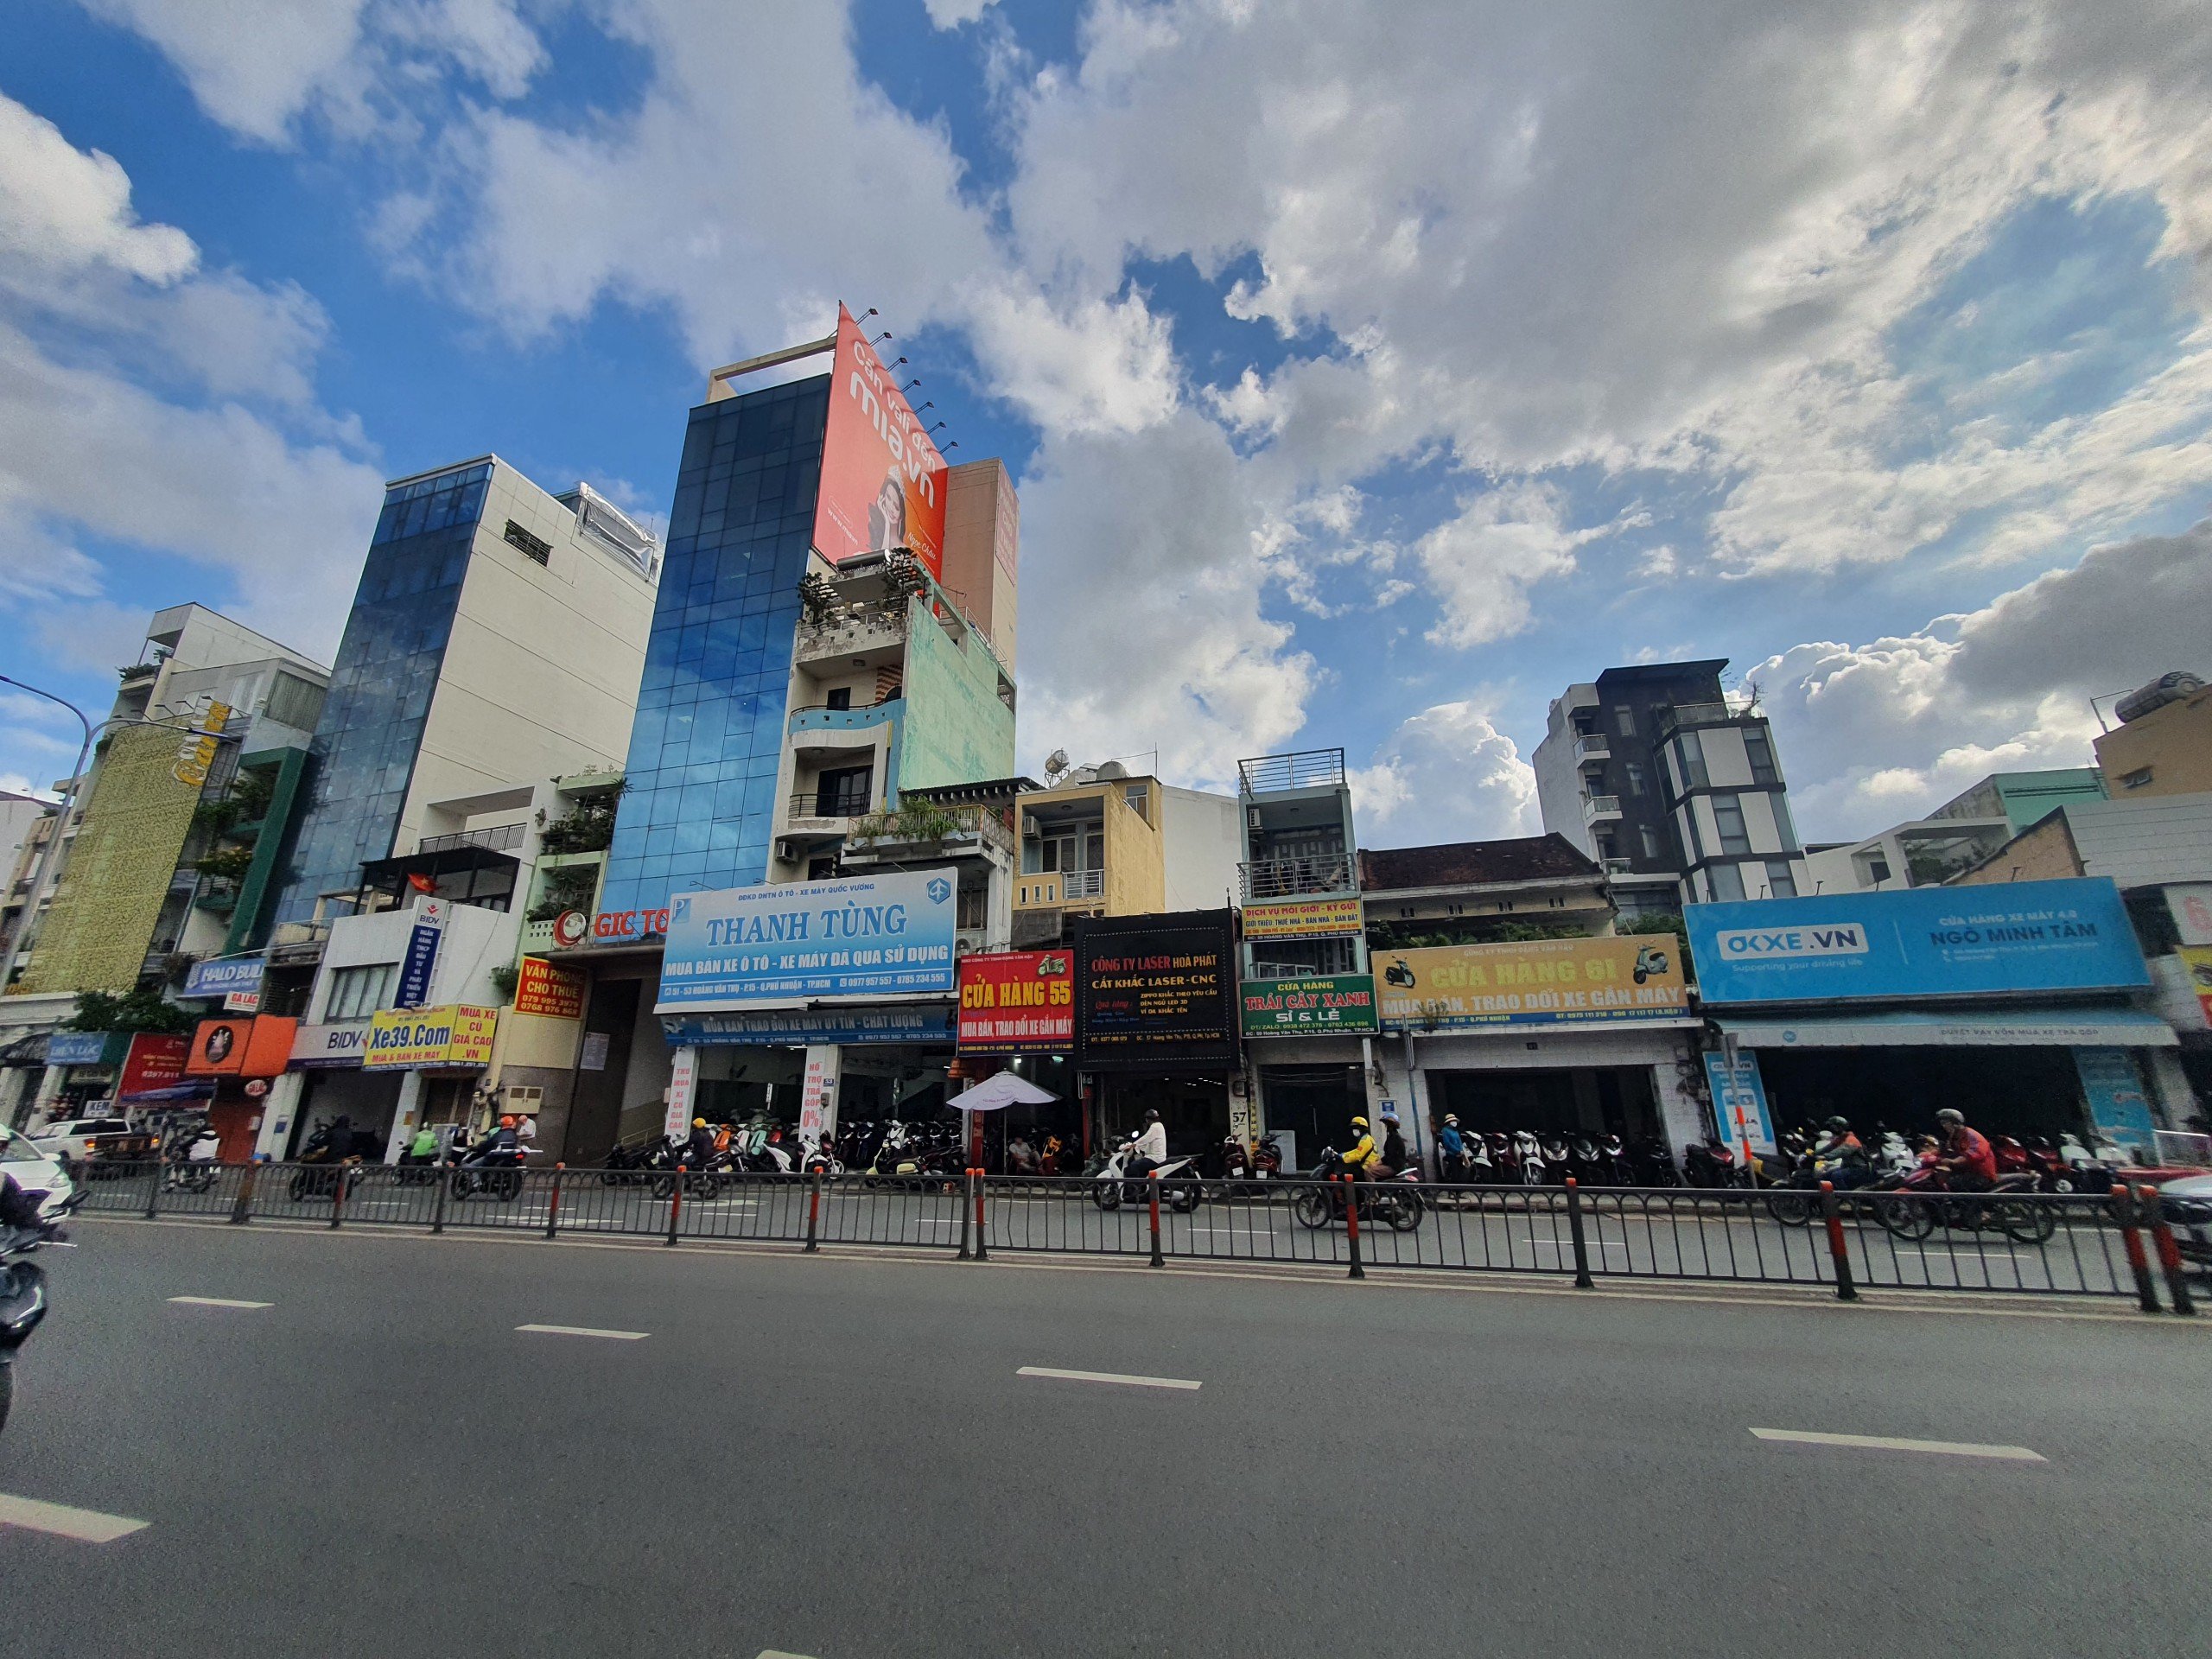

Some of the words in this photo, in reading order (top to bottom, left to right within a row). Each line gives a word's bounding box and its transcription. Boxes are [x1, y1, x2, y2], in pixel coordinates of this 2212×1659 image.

[854, 340, 883, 396] Cần
[887, 390, 911, 435] vali
[912, 431, 936, 474] đến
[908, 531, 922, 549] Ngọc
[785, 888, 794, 898] TÔ
[810, 886, 826, 895] MÁY
[828, 884, 848, 894] QUỐC
[849, 883, 874, 892] VƯƠNG
[1246, 908, 1266, 918] DỊCH
[1268, 907, 1281, 917] VỤ
[1300, 904, 1319, 914] GIỚI
[1326, 901, 1339, 912] KÝ
[1339, 899, 1357, 911] GỬI
[420, 914, 440, 925] BIDV
[594, 910, 636, 938] GIC
[706, 912, 810, 947] THANH
[821, 899, 907, 939] TÙNG
[1289, 916, 1301, 925] NHÀ
[1318, 914, 1330, 924] NHÀ
[1939, 915, 1966, 926] CỬA
[1968, 913, 2005, 925] HÀNG
[2008, 913, 2024, 922] XE
[2027, 909, 2054, 920] MÁY
[1929, 926, 1981, 946] NGÔ
[1986, 925, 2045, 942] MINH
[2049, 920, 2099, 938] TÂM
[665, 961, 692, 976] MUA
[696, 957, 721, 974] BÁN
[722, 958, 738, 973] XE
[741, 955, 749, 970] Ô
[753, 954, 769, 970] TÔ
[779, 954, 795, 969] XE
[798, 950, 828, 968] MÁY
[830, 950, 850, 966] ĐÃ
[853, 950, 881, 965] QUA
[885, 944, 905, 963] SỬ
[907, 944, 948, 965] DỤNG
[1091, 955, 1121, 973] CÔNG
[1123, 957, 1137, 971] TY
[1137, 956, 1171, 970] LASER
[1173, 953, 1191, 969] HOÀ
[1192, 951, 1217, 967] PHÁT
[1732, 963, 1786, 973] Supporting
[1788, 962, 1809, 970] your
[1811, 959, 1846, 969] driving
[1847, 958, 1863, 967] life
[201, 966, 236, 982] HALO
[525, 964, 549, 979] VĂN
[849, 977, 864, 987] 0977
[866, 976, 878, 986] 957
[879, 976, 892, 985] 557
[897, 975, 914, 984] 0785
[915, 974, 930, 983] 234
[931, 973, 945, 982] 555
[1430, 958, 1488, 988] CỬA
[1495, 956, 1577, 986] HÀNG
[526, 981, 550, 994] CHO
[551, 984, 580, 999] THUÊ
[1091, 976, 1113, 989] CẮT
[1115, 974, 1146, 988] KHẮC
[1277, 982, 1300, 991] CỬA
[1303, 980, 1334, 990] HÀNG
[962, 974, 995, 1008] CỬA
[1000, 976, 1045, 1007] HÀNG
[1049, 981, 1071, 1006] 55
[1382, 998, 1423, 1015] MUA
[1471, 994, 1521, 1011] TRAO
[1525, 987, 1560, 1009] ĐỔI
[1564, 990, 1586, 1007] XE
[1635, 984, 1680, 1005] MÁY
[544, 1005, 560, 1014] 976
[1245, 993, 1283, 1011] TRÁI
[1287, 991, 1319, 1008] CÂY
[1323, 991, 1370, 1007] XANH
[460, 1007, 481, 1019] MUA
[483, 1008, 497, 1020] XE
[790, 1019, 800, 1030] XE
[824, 1018, 836, 1030] UY
[838, 1014, 855, 1029] TÍN
[1275, 1010, 1293, 1022] SỈ
[1299, 1012, 1313, 1022] &
[1318, 1008, 1340, 1021] LẺ
[961, 1021, 977, 1037] MUA
[995, 1020, 1014, 1036] TRAO
[1014, 1014, 1027, 1036] ĐỔI
[1029, 1020, 1039, 1035] XE
[1039, 1014, 1054, 1035] GẮN
[1056, 1015, 1072, 1035] MÁY
[327, 1030, 363, 1049] BIDV
[370, 1024, 451, 1050] Xe39.Com
[473, 1036, 492, 1046] CAO
[462, 1049, 480, 1059] .VN
[804, 1096, 821, 1107] GÓP
[803, 1109, 819, 1128] 0%
[1232, 1111, 1247, 1123] 57
